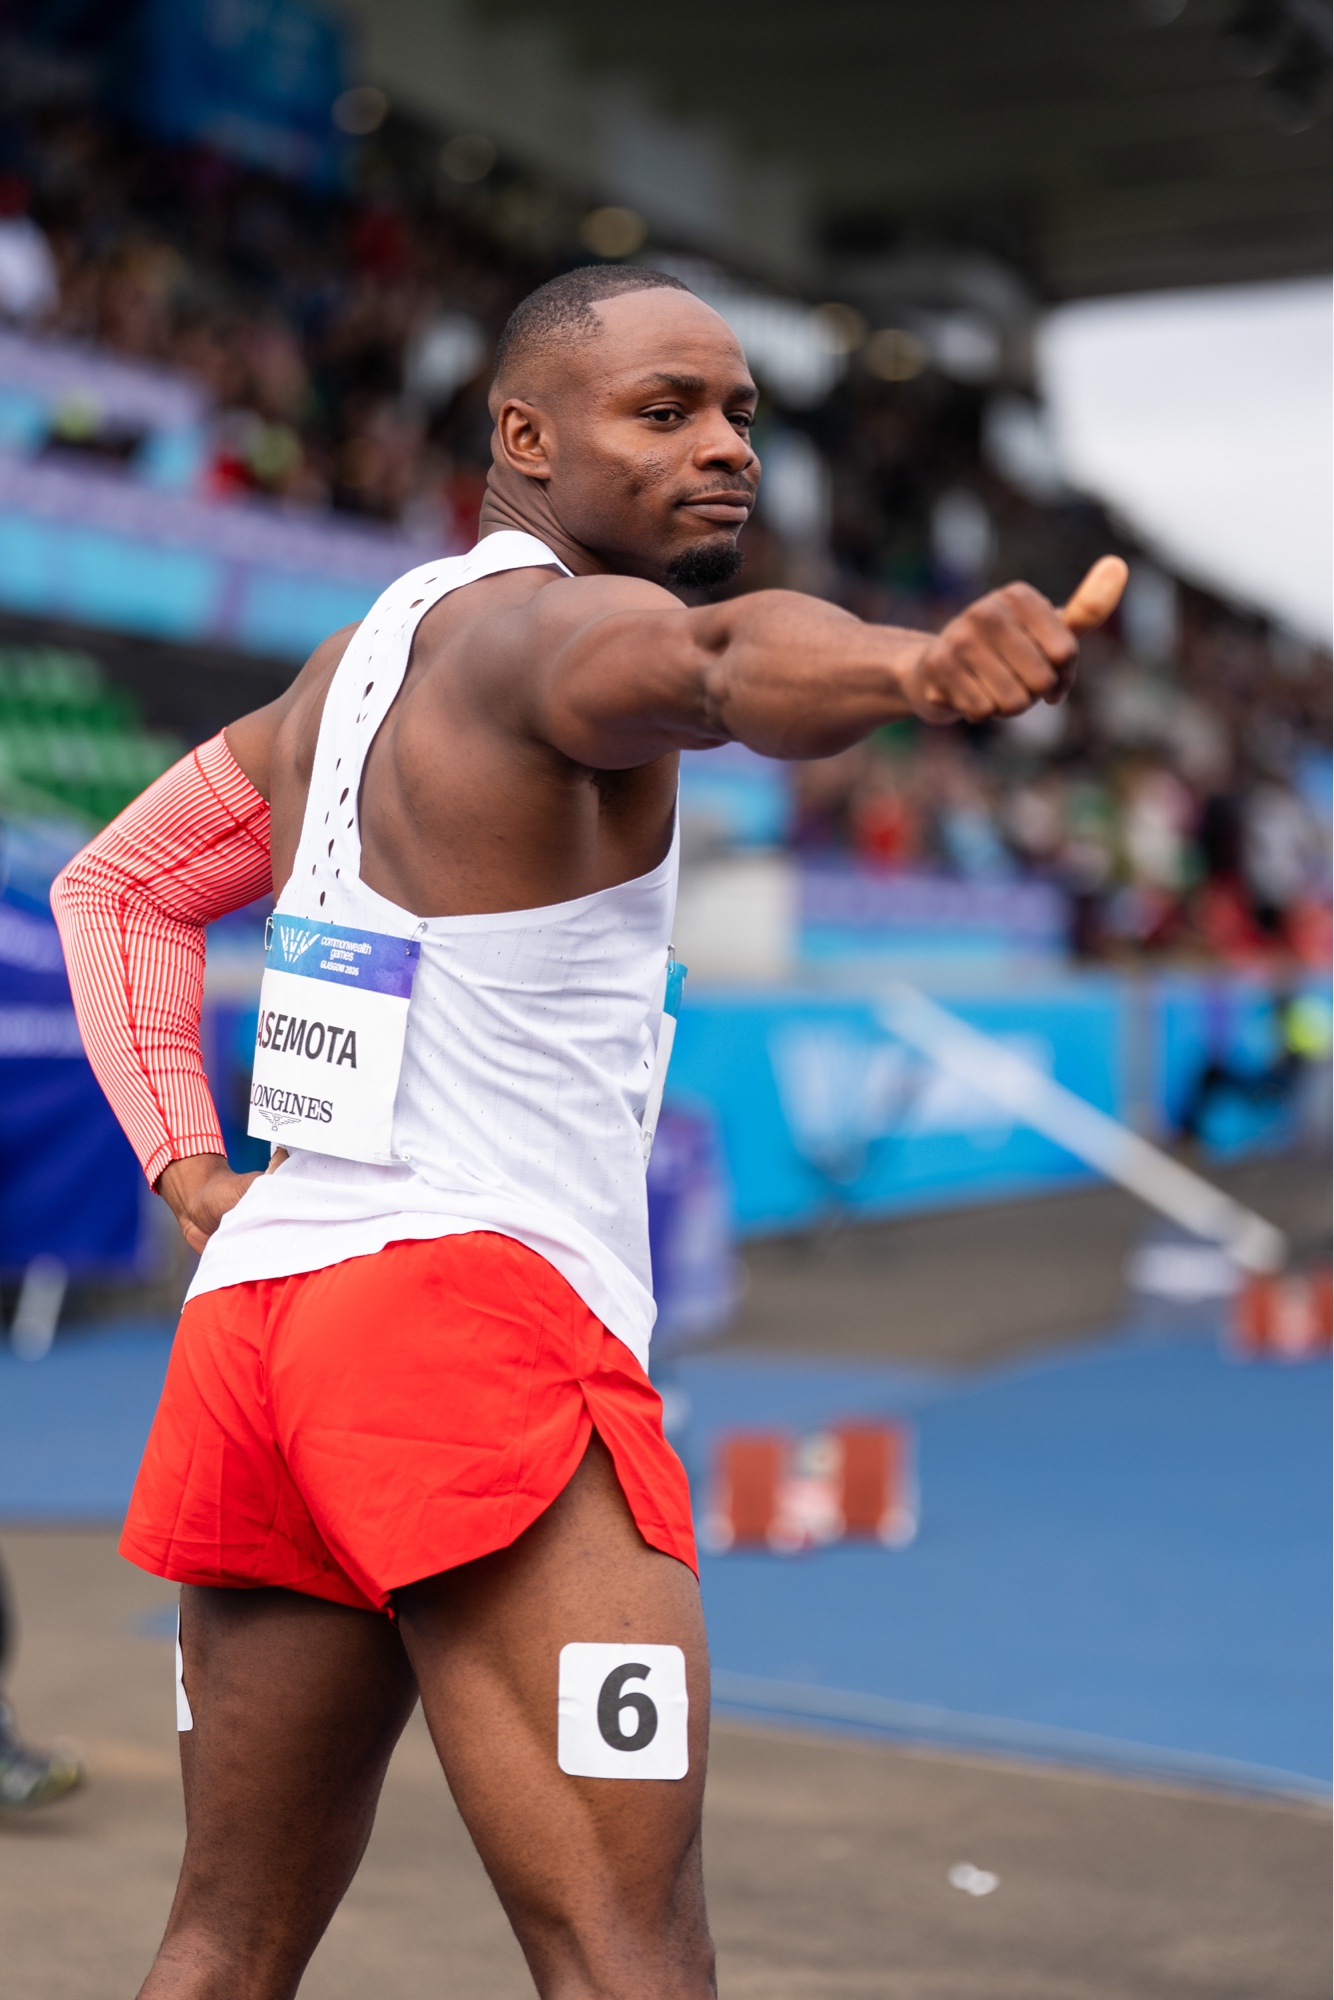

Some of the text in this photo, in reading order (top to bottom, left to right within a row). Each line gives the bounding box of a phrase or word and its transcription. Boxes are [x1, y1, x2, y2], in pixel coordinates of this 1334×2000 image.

[321, 936, 372, 955] commonwealth
[330, 948, 354, 961] games
[320, 960, 359, 976] GLASGOW 2026
[257, 1010, 357, 1069] ASEMOTA
[597, 1662, 658, 1752] 6
